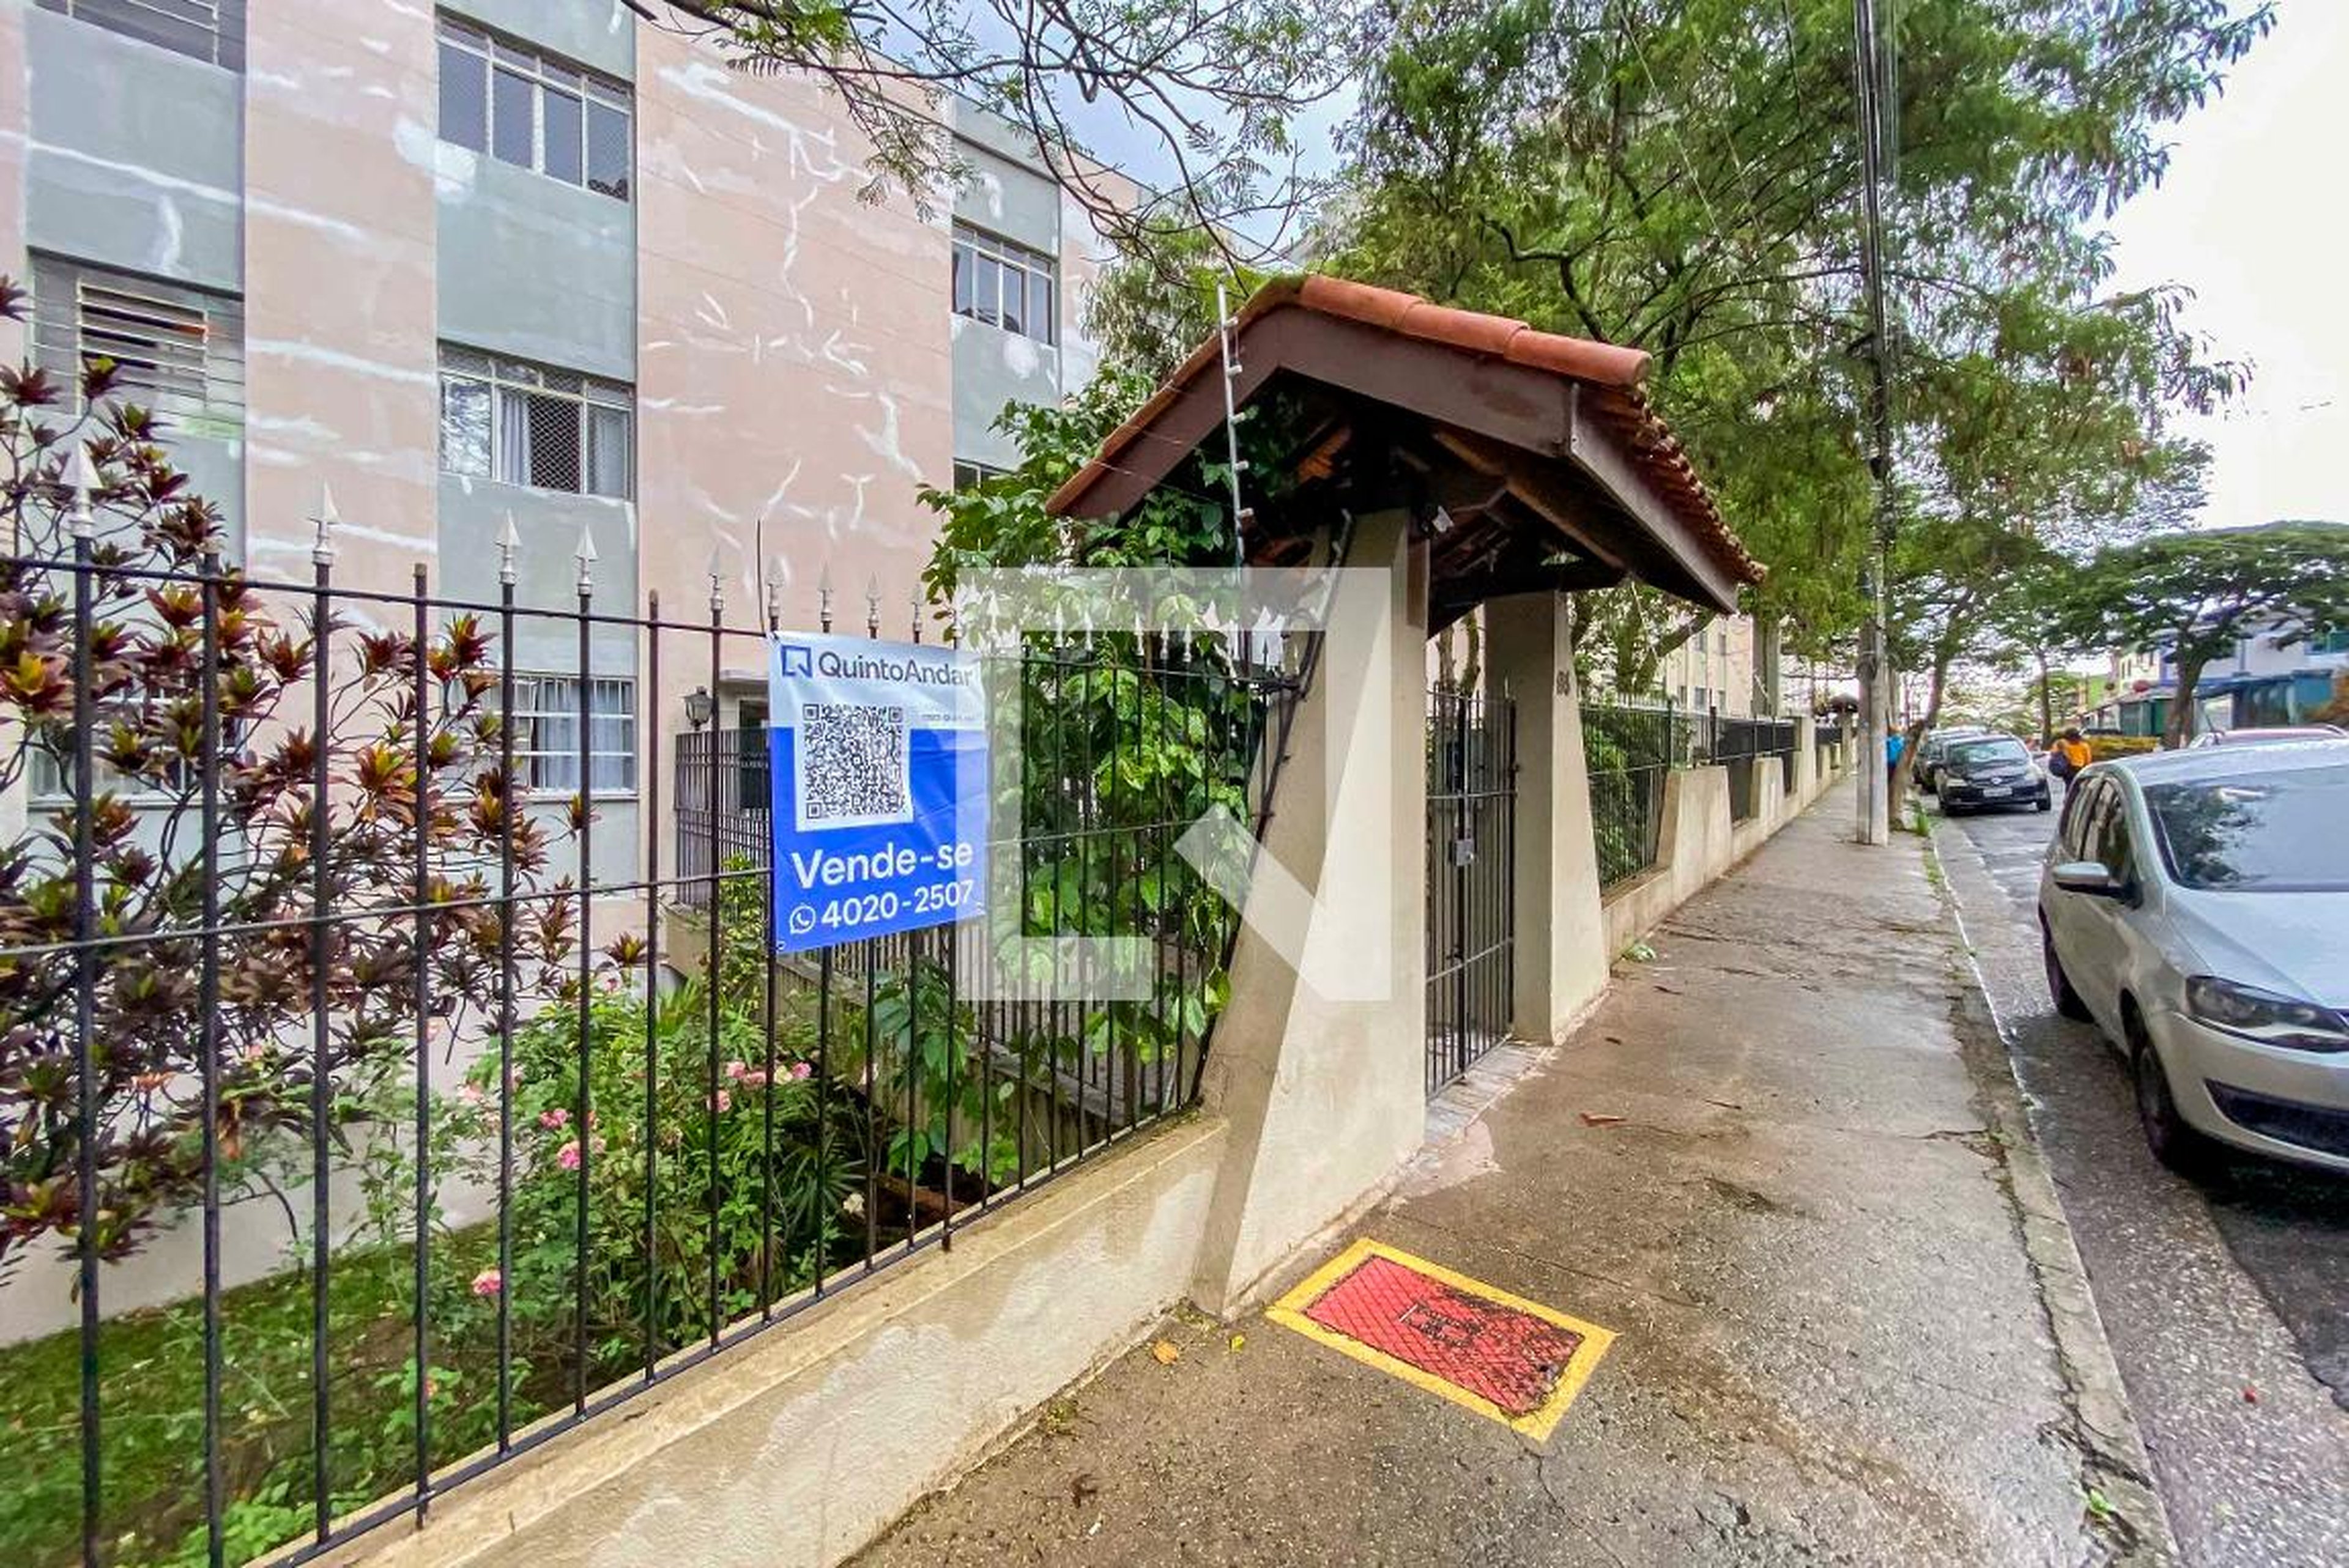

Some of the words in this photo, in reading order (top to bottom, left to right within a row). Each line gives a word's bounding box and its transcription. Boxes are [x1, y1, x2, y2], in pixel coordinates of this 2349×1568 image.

[818, 651, 973, 686] QuintoAndar
[792, 842, 973, 889] Vende-se
[821, 879, 974, 928] 4020-2507
